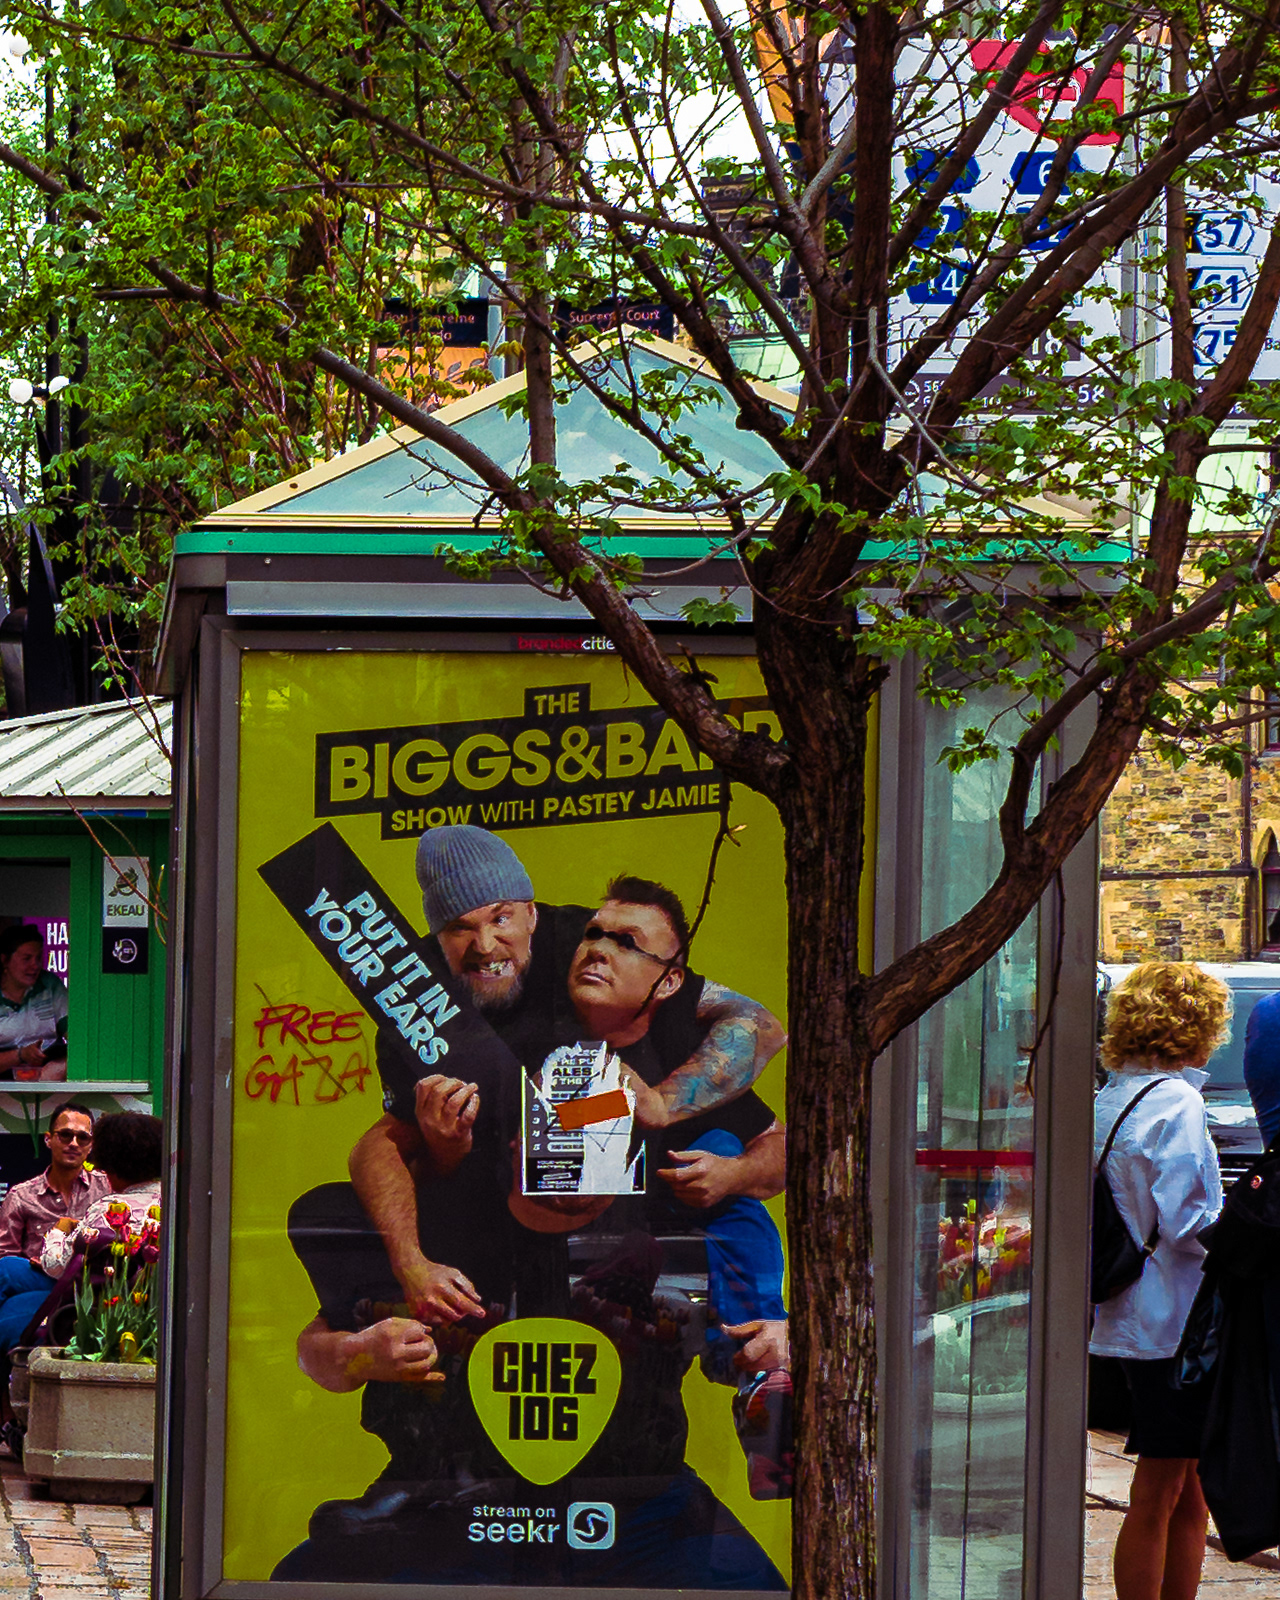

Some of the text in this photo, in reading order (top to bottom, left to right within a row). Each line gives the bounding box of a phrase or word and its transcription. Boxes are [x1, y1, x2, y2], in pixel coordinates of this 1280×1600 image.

[534, 691, 580, 716] THE
[329, 711, 784, 802] BIGGS&BA
[391, 783, 721, 832] SHOW WITH PASTEY JAMIE
[106, 904, 145, 917] EKEAU
[304, 887, 449, 1065] YOUR EARS
[343, 890, 461, 1028] PUT IT IN
[254, 1003, 365, 1048] FREE
[244, 1052, 372, 1106] GAZA
[492, 1341, 598, 1394] CHEZ
[508, 1395, 579, 1442] 106
[467, 1519, 560, 1543] seekr
[472, 1504, 556, 1518] stream on
